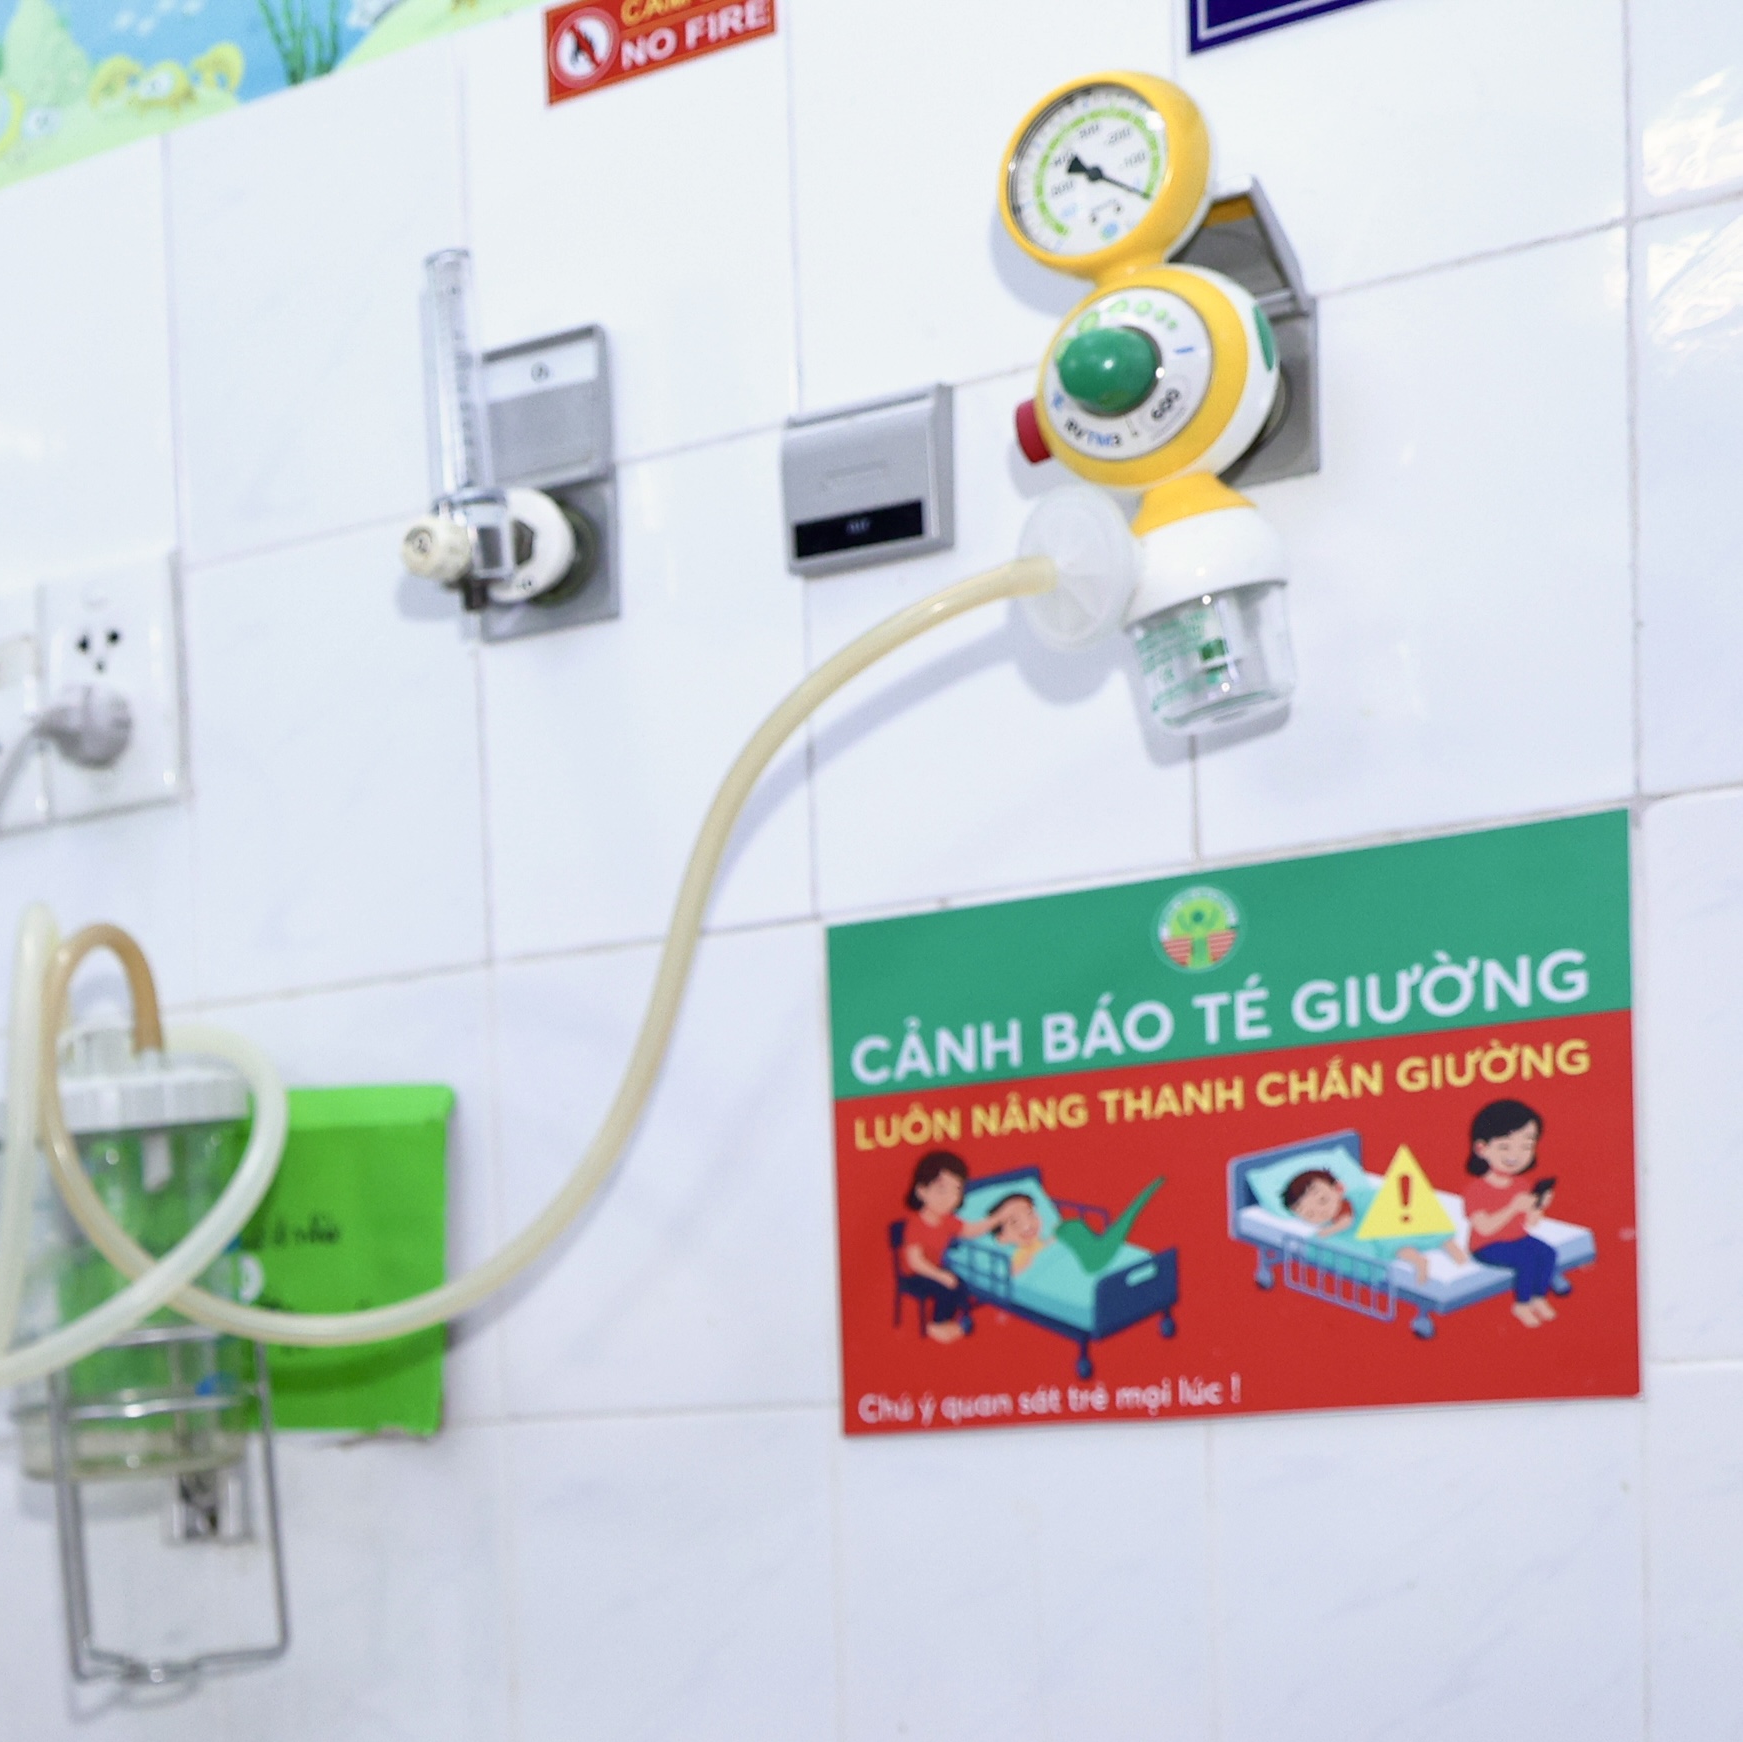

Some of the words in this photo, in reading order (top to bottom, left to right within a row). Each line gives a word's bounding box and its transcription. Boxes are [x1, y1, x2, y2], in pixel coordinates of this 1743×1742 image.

[621, 27, 677, 71] NO
[685, 0, 771, 49] FIRE
[851, 1015, 1022, 1085] CẢNH
[1042, 992, 1175, 1064] BÁO
[1192, 973, 1272, 1044] TÉ
[1291, 949, 1589, 1033] GIƯỜNG
[854, 1102, 962, 1151] LUÔN
[971, 1090, 1089, 1138] NÂNG
[1097, 1076, 1245, 1126] THANH
[1256, 1055, 1383, 1107] CHẮN
[1395, 1038, 1591, 1093] GIƯỜNG
[857, 1391, 914, 1424] Chú
[918, 1390, 936, 1427] ý
[940, 1391, 1013, 1426] quan
[1017, 1383, 1061, 1415] sát
[1115, 1376, 1172, 1417] mọi
[1178, 1374, 1221, 1407] lúc
